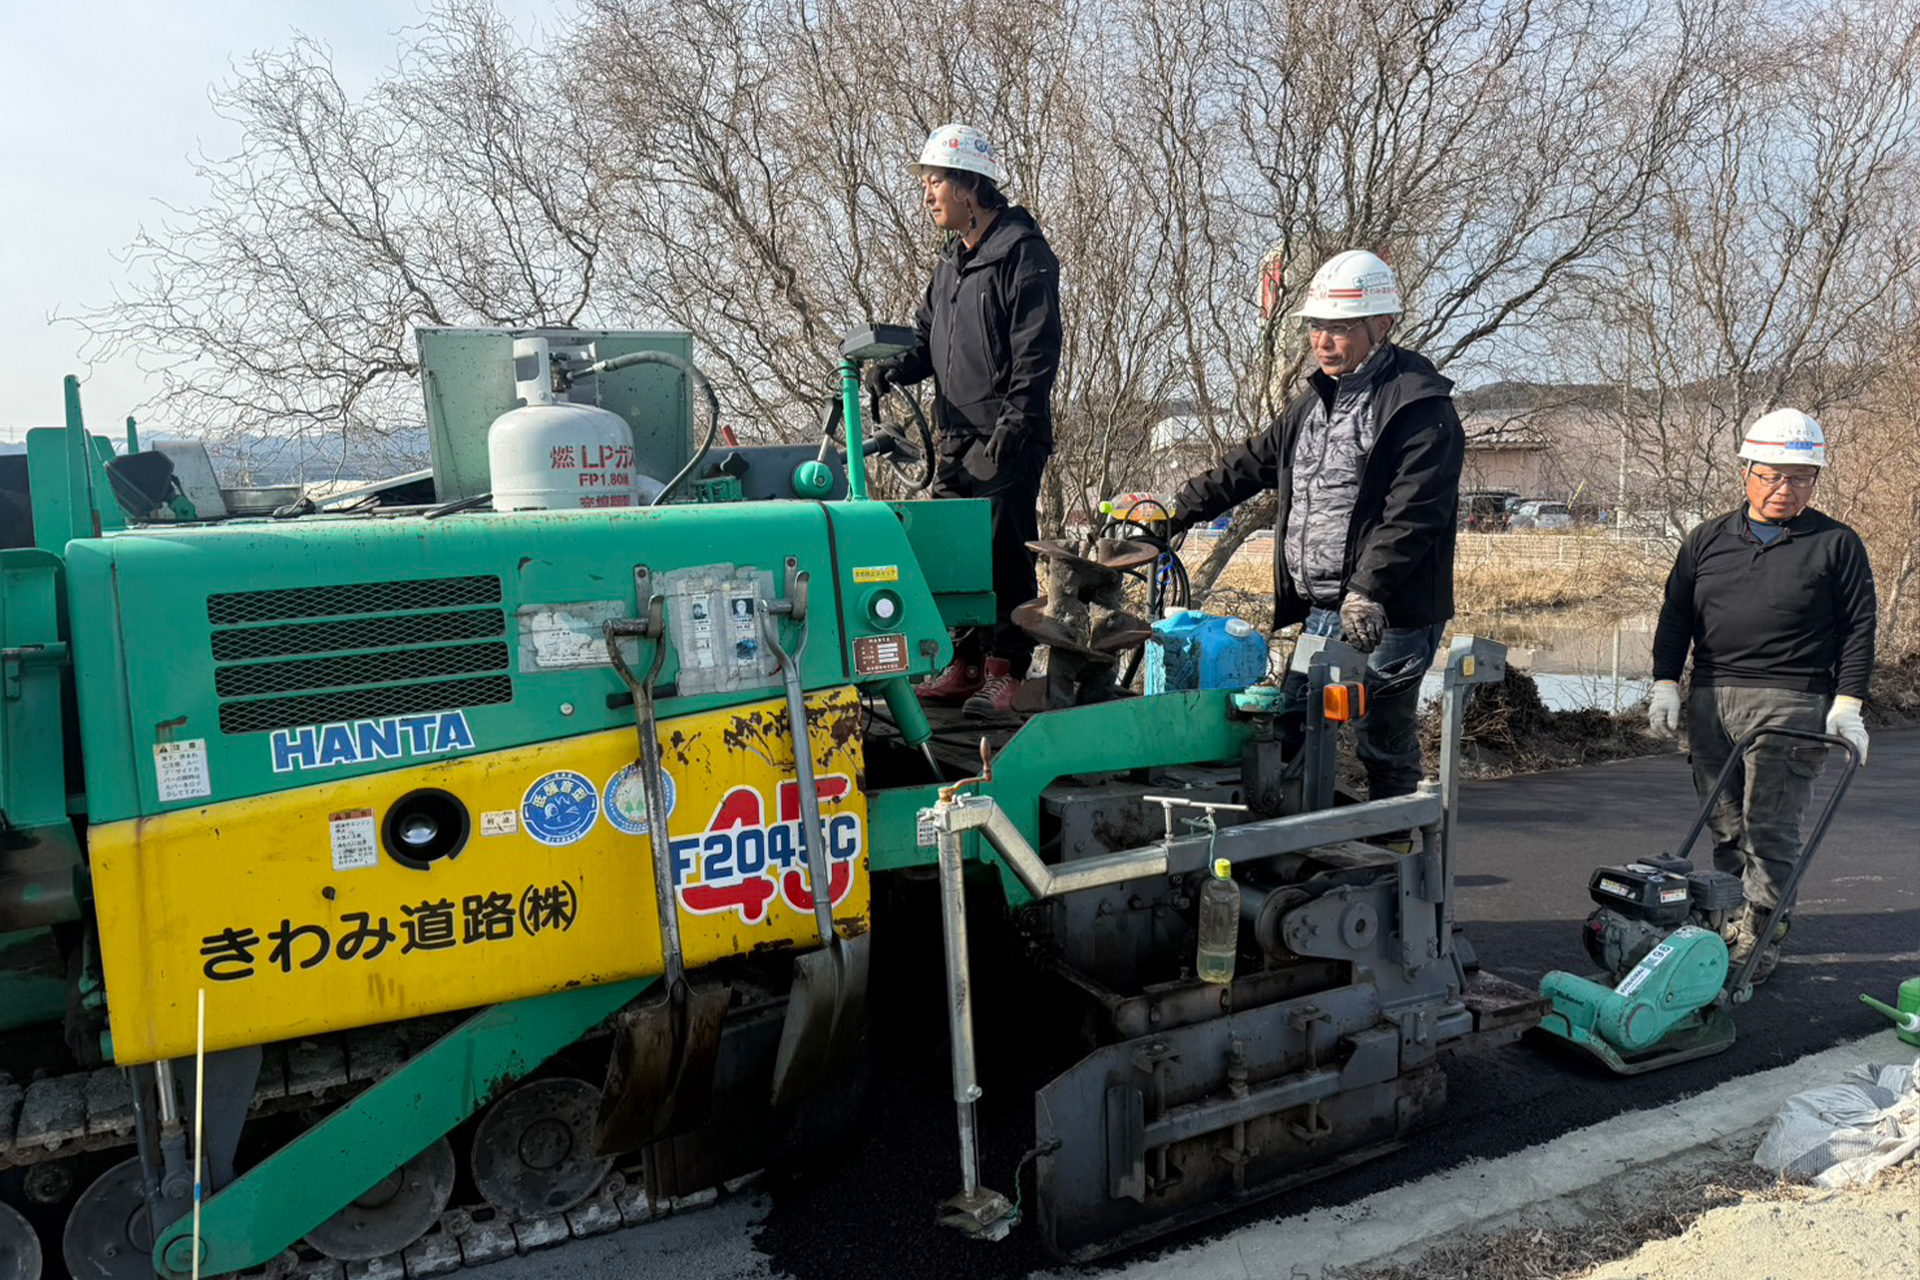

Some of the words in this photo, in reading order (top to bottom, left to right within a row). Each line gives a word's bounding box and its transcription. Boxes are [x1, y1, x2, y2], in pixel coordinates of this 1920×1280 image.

[550, 445, 575, 469] 燃
[271, 710, 475, 772] HANTA
[532, 780, 588, 809] 低騒音型
